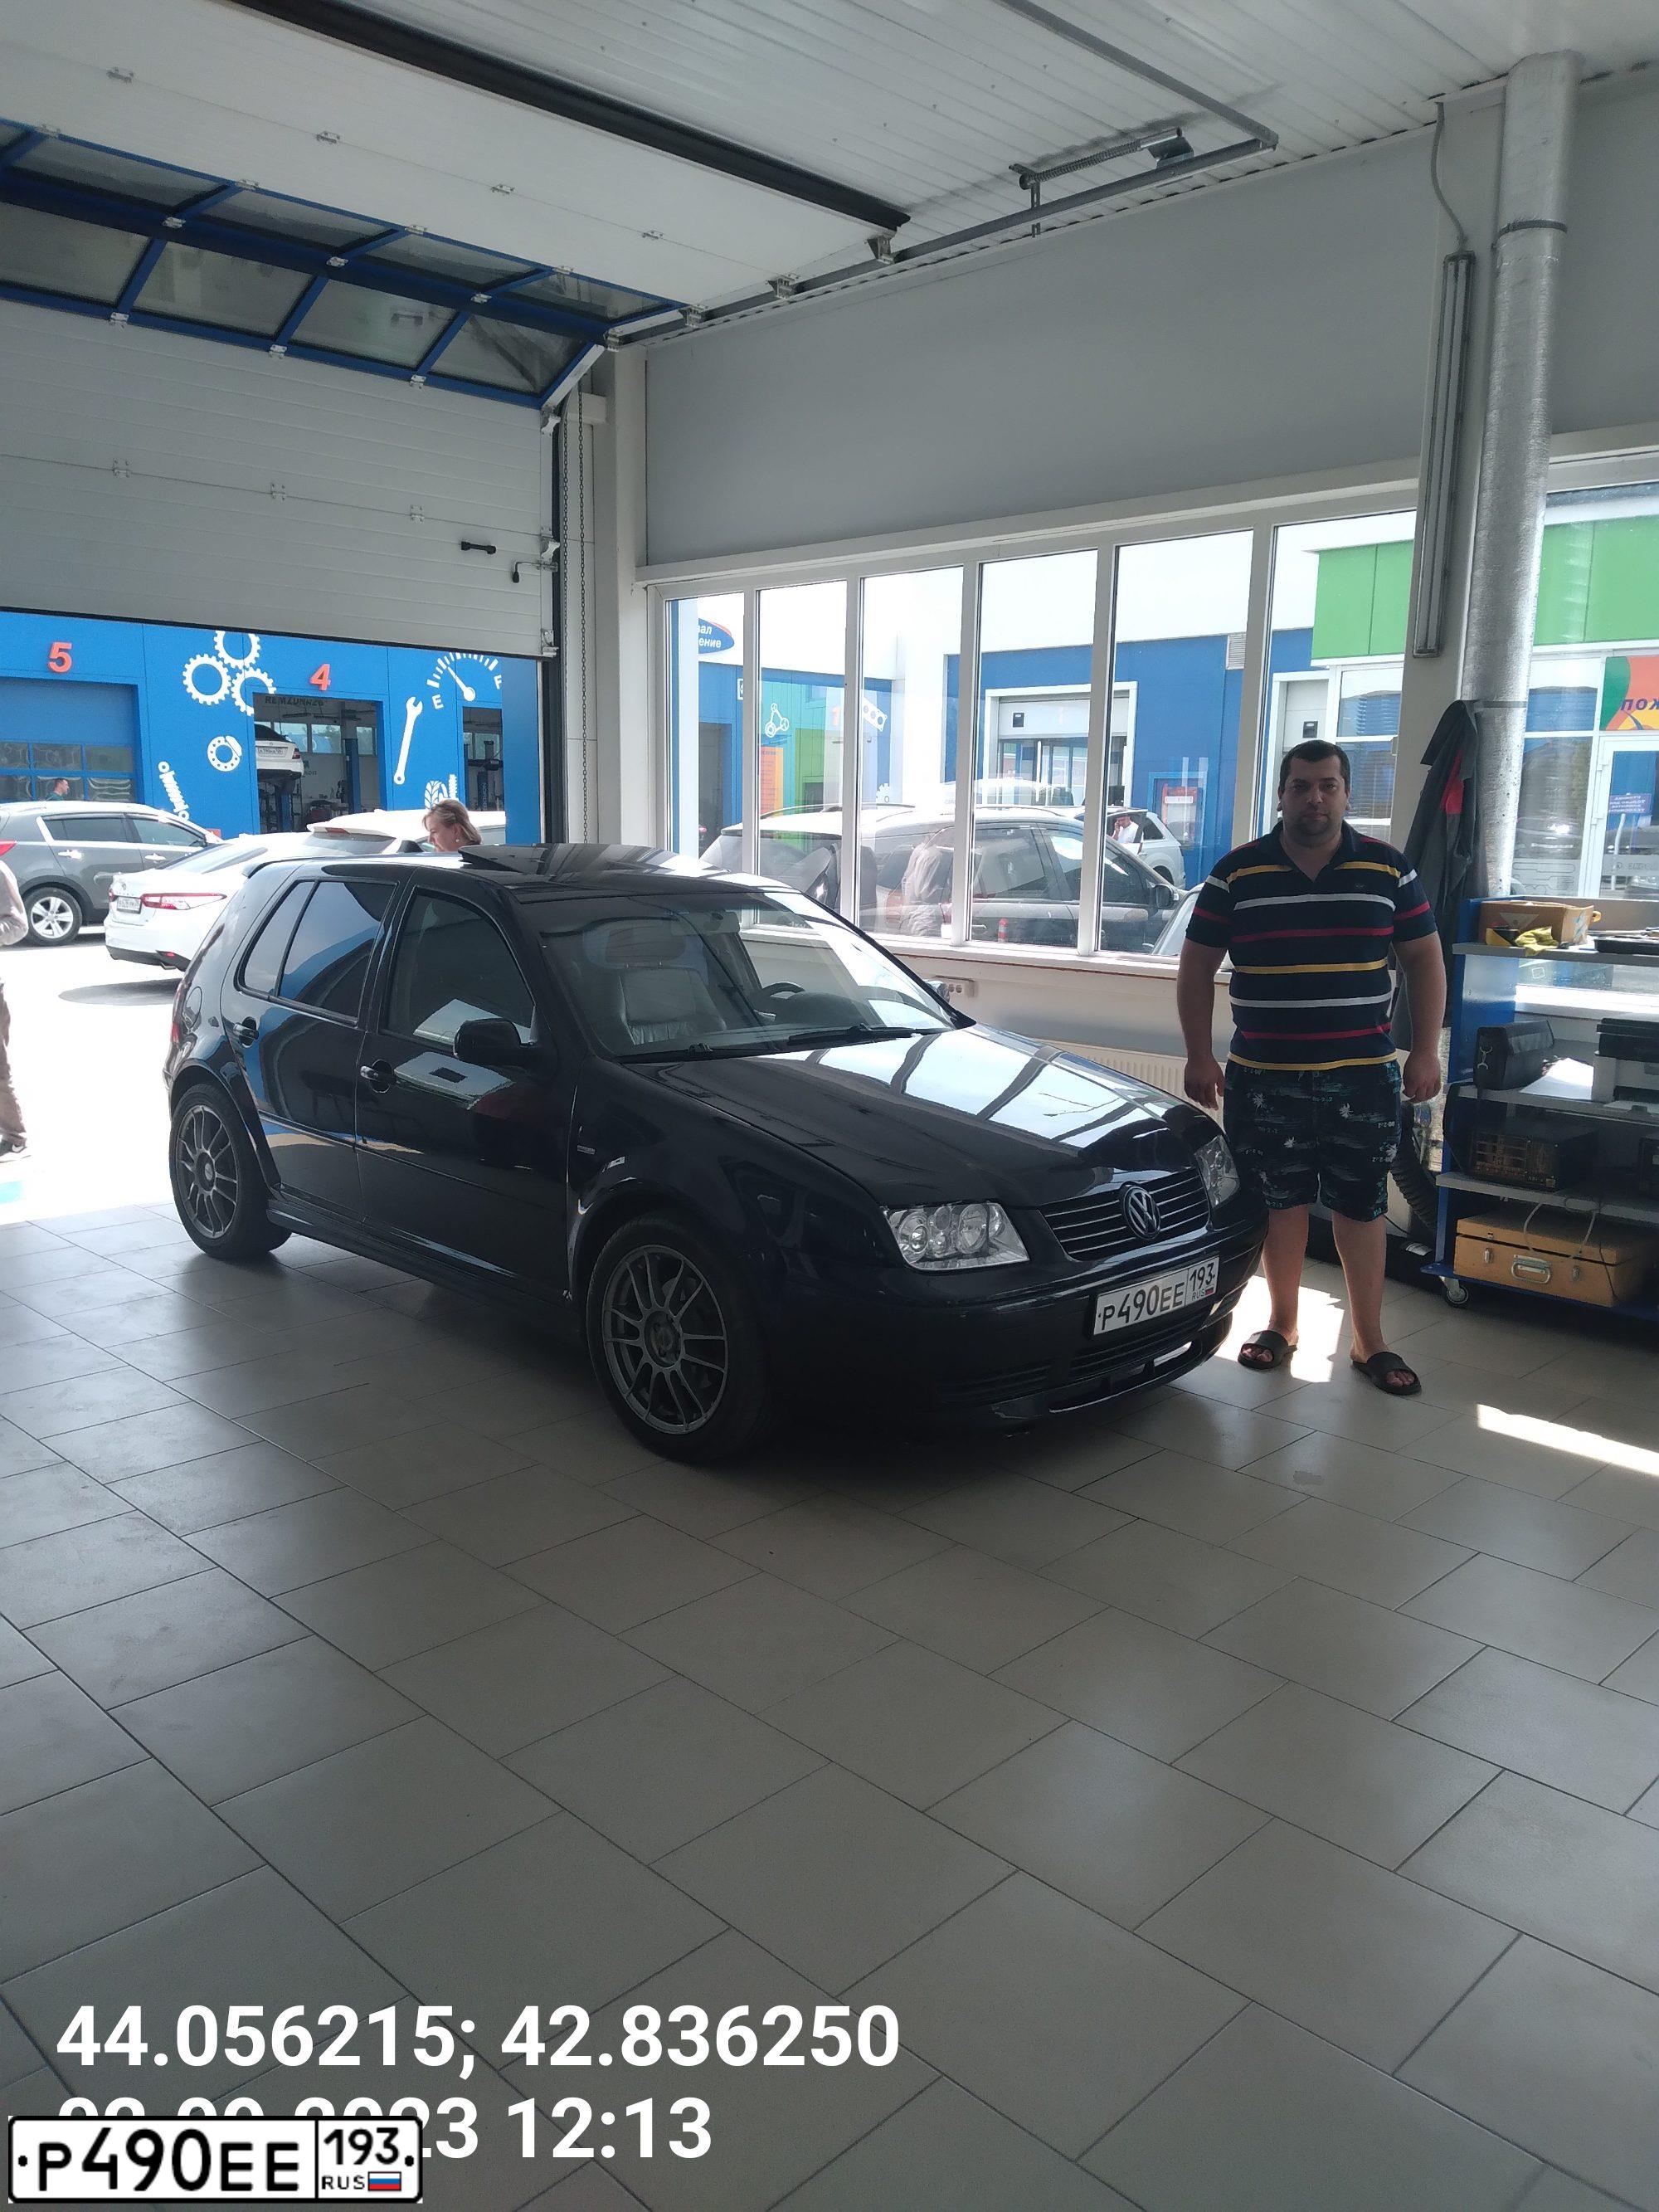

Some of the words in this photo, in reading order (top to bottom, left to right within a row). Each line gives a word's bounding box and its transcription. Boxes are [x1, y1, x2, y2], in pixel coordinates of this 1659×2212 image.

[48, 642, 72, 673] 5
[310, 664, 332, 691] 4
[431, 694, 445, 710] E
[1190, 1262, 1214, 1292] 193
[1191, 1288, 1206, 1301] RUS
